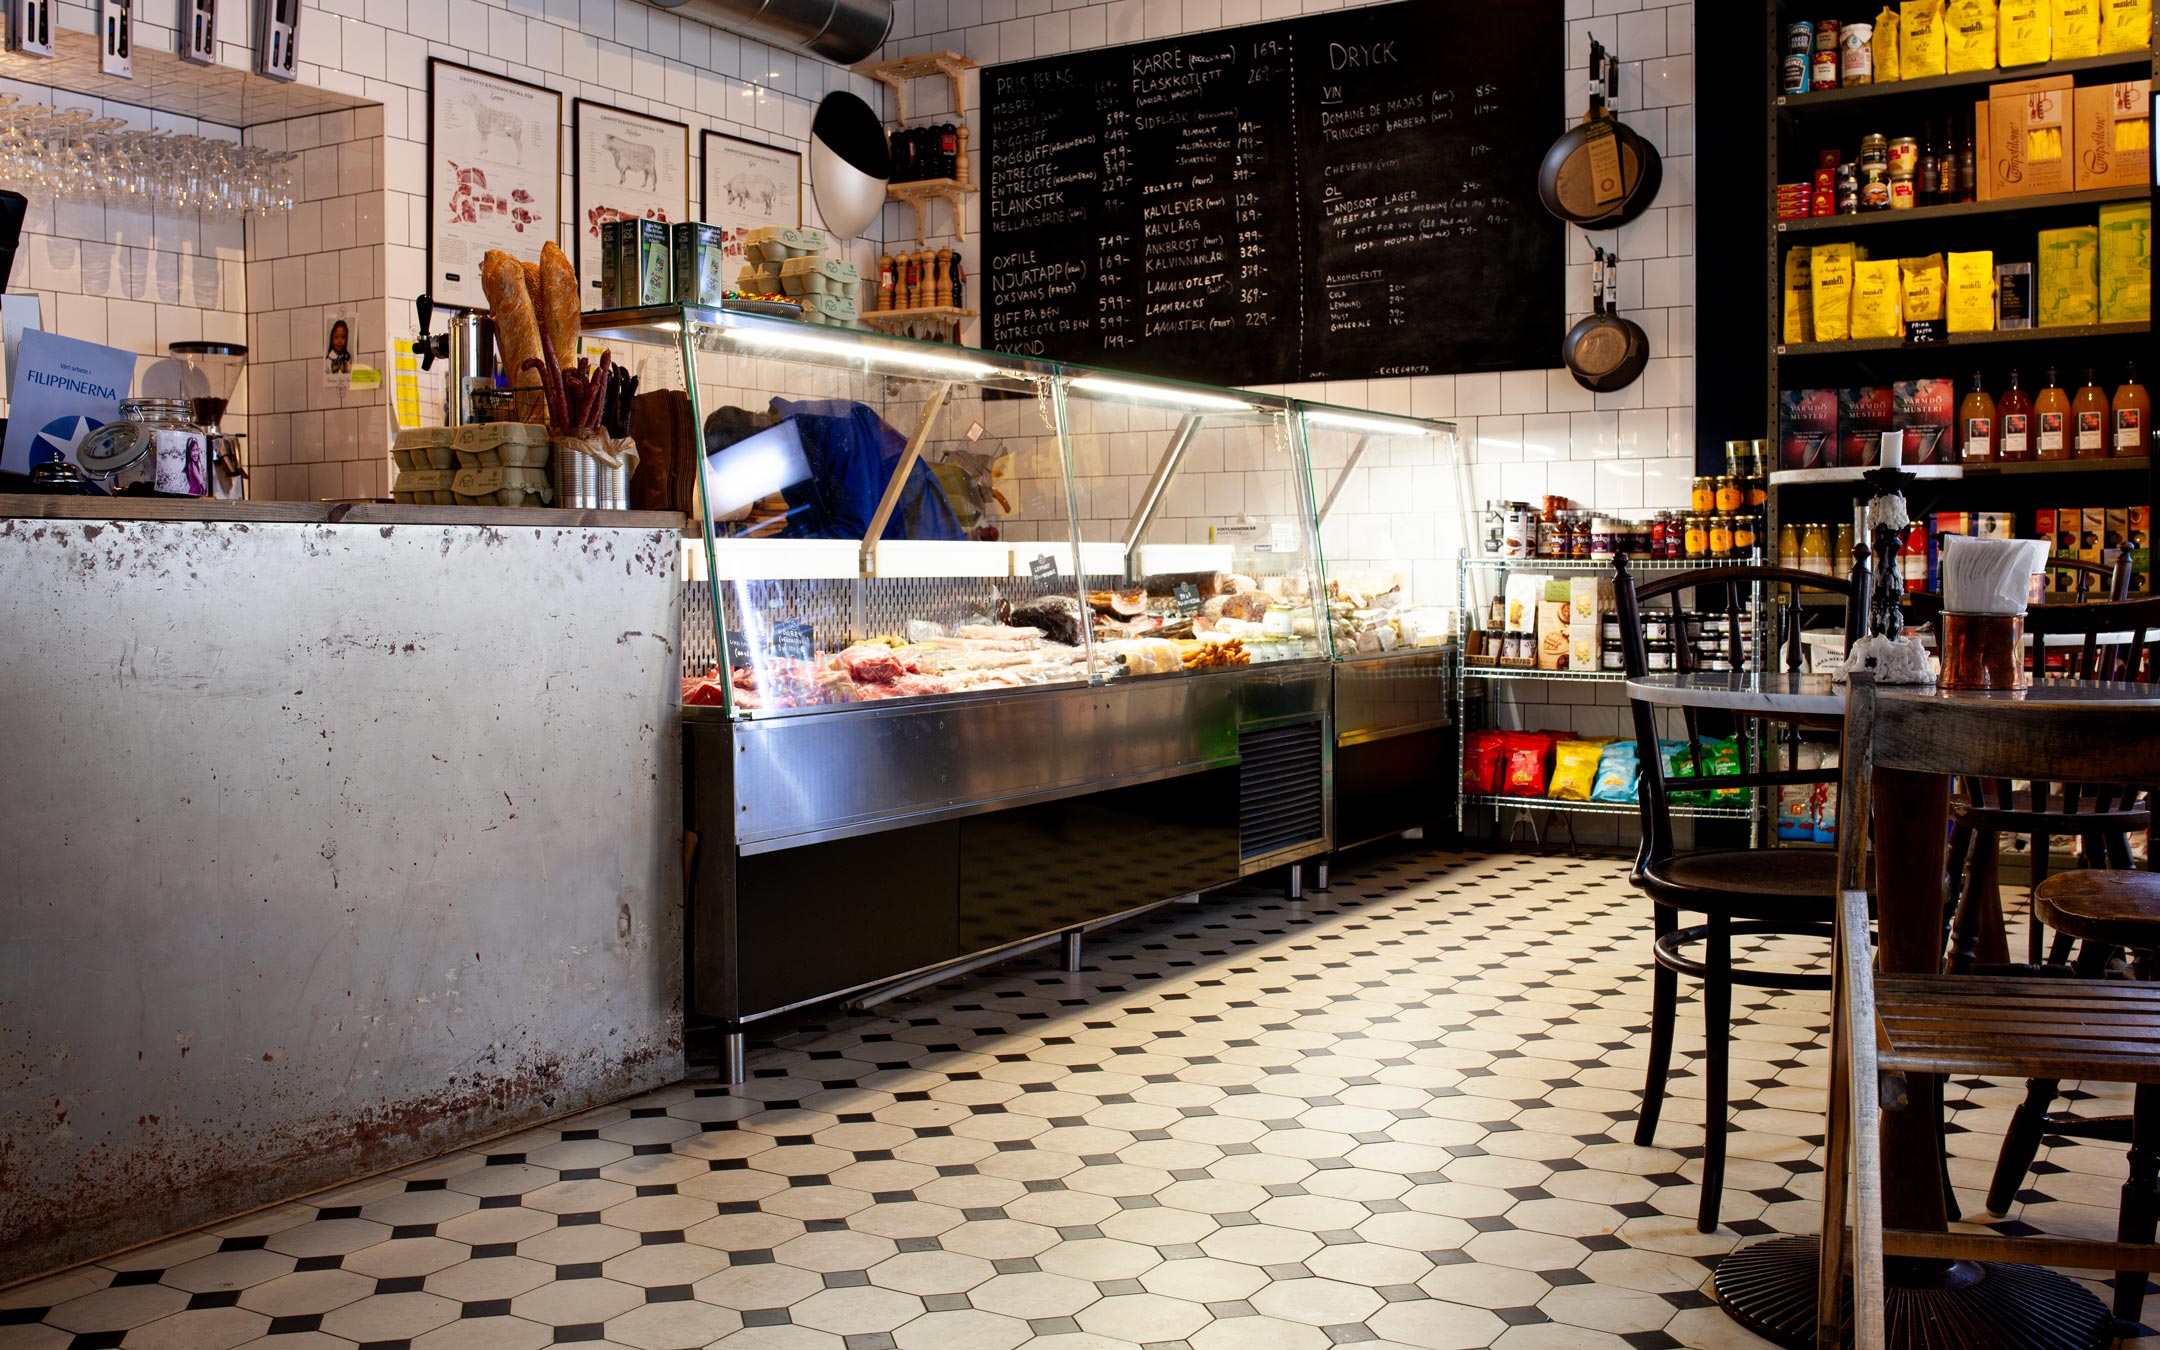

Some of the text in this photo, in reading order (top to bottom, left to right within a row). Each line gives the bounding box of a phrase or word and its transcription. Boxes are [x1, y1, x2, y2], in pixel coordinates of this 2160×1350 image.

[1328, 40, 1399, 71] DRYCK
[997, 67, 1073, 96] PRIS PER KG
[1322, 86, 1342, 100] VIN
[1321, 107, 1365, 128] DOMAINE
[1370, 104, 1382, 117] DE
[1321, 123, 1380, 144] TRINCHERO
[992, 144, 1051, 170] RYGGBIFF
[1324, 160, 1374, 177] CHEVERNY
[991, 176, 1053, 199] ENTRECOTE
[1142, 180, 1184, 196] SECRETO
[1324, 183, 1343, 197] ÖL
[991, 191, 1065, 218] FLANKSTEK
[1143, 197, 1205, 221] KALVLEVER
[1325, 196, 1380, 217] LANDSORT
[1384, 190, 1419, 206] LAGER
[1333, 212, 1360, 227] MEET
[1362, 210, 1378, 220] ME
[1381, 208, 1390, 217] IN
[1394, 205, 1408, 215] THE
[1412, 201, 1448, 213] MORNING
[1336, 229, 1347, 239] IF
[1354, 225, 1374, 236] NOT
[1377, 222, 1394, 232] FOR
[1398, 221, 1414, 231] YOU
[1354, 240, 1375, 253] HOP
[1384, 233, 1415, 247] HOUND
[992, 250, 1038, 271] OXFILE
[992, 262, 1064, 293] NJURTAPP
[1326, 268, 1385, 285] ALKOHOLFRITT
[994, 286, 1046, 307] OXSVANS
[1328, 290, 1348, 300] COLA
[1145, 298, 1205, 317] LAMMRACKS
[1329, 300, 1362, 312] LEMONAD
[994, 310, 1022, 329] BIFF
[1041, 306, 1061, 319] BEN
[1330, 312, 1350, 322] MUST
[994, 321, 1056, 342] ENTRECOTE
[1074, 318, 1091, 331] BEN
[1145, 318, 1207, 338] LAMMSTEK
[71, 364, 88, 374] arbete
[27, 369, 116, 401] FILIPPINERNA
[1790, 412, 1827, 420] MUSTERI
[1849, 410, 1886, 419] MUSTERI
[1903, 405, 1942, 414] MUSTERI
